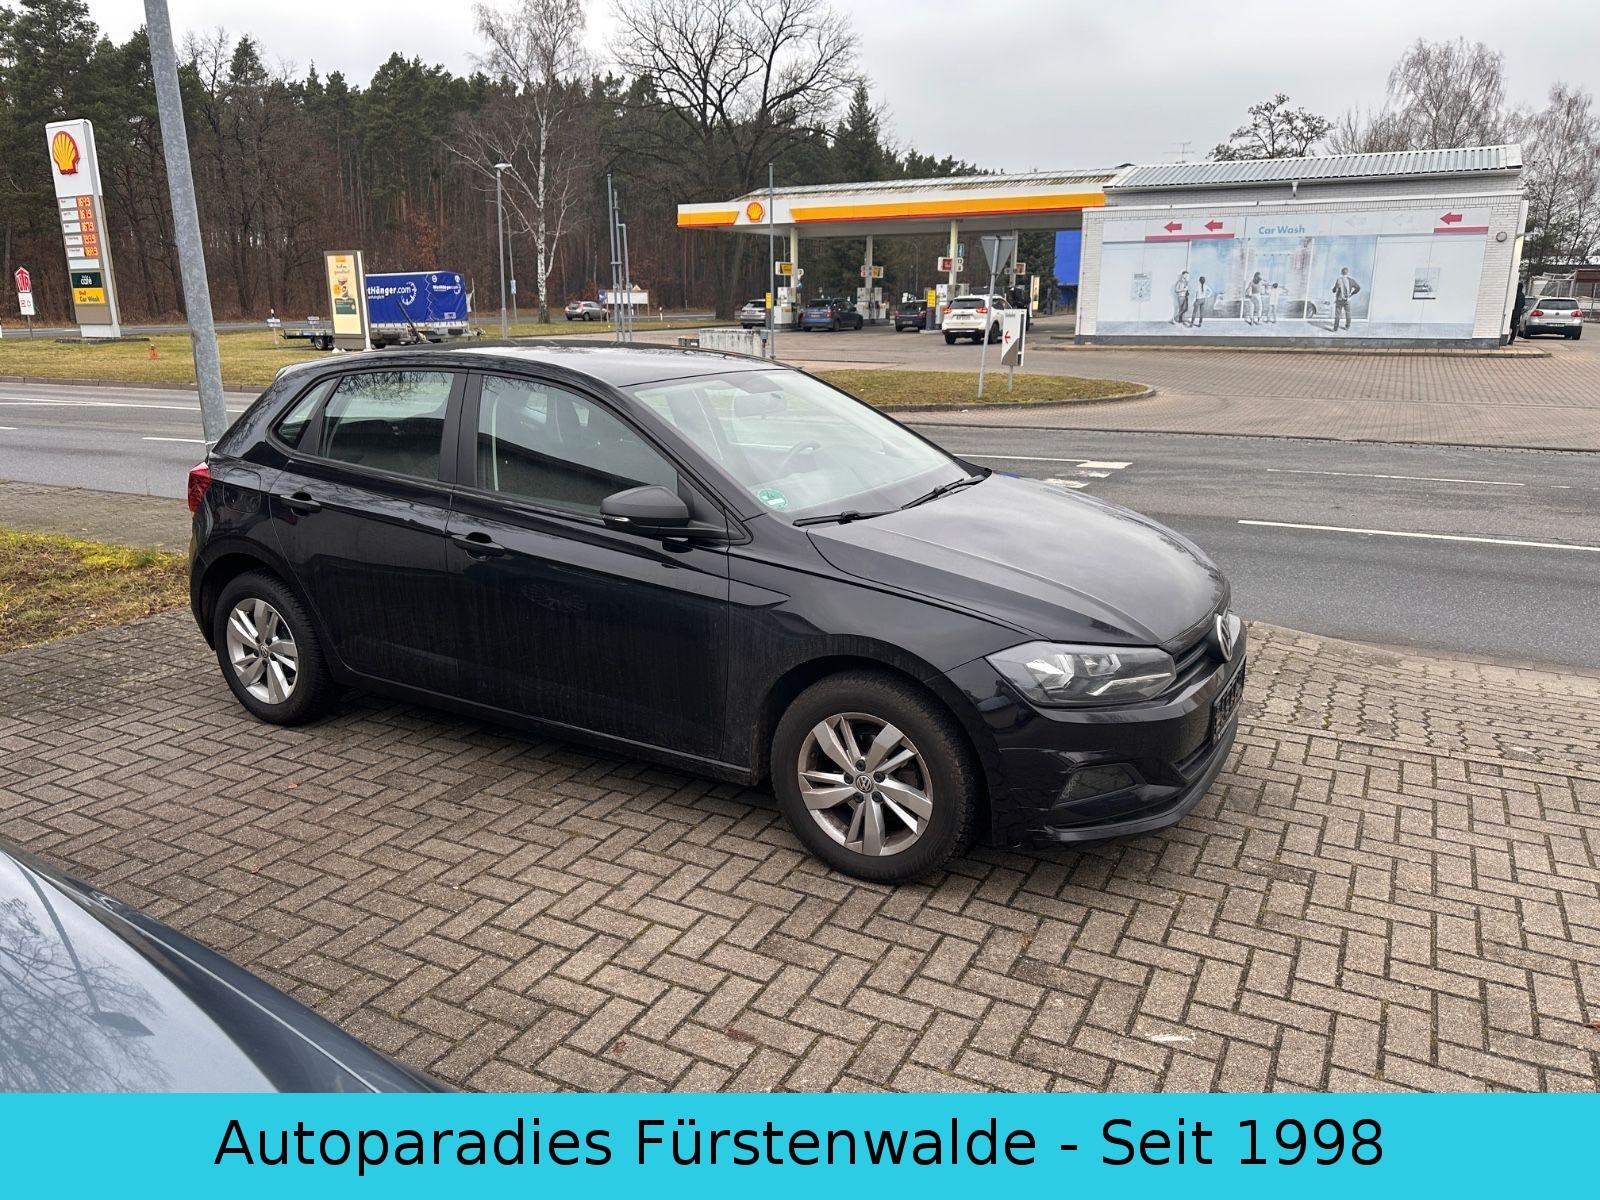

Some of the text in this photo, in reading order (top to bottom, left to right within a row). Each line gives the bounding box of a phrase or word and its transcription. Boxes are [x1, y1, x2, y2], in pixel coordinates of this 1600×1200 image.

[1259, 224, 1305, 235] Car Wash
[367, 286, 411, 296] tHänger.com
